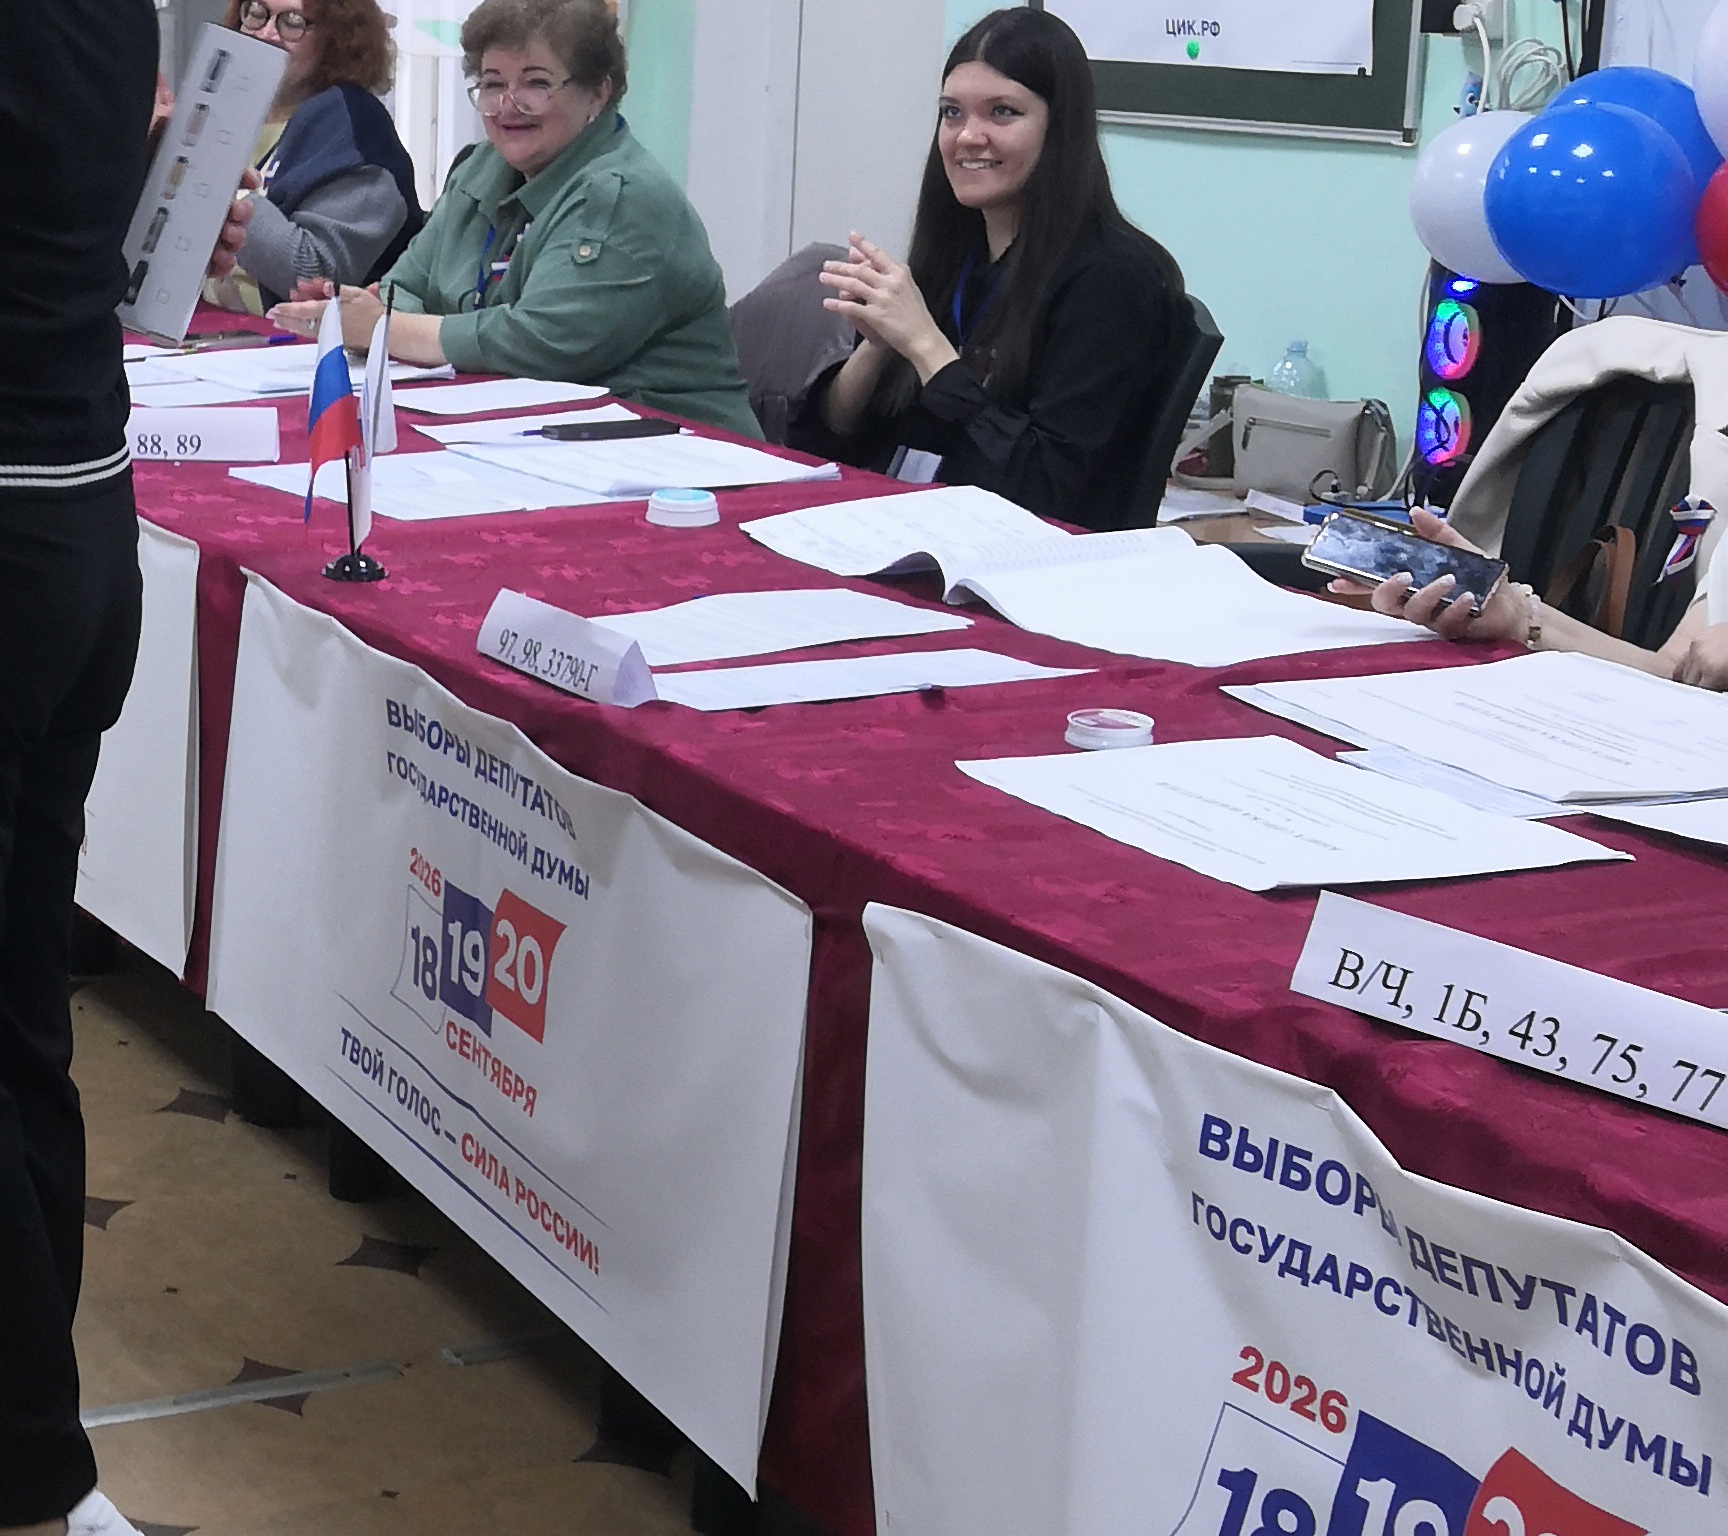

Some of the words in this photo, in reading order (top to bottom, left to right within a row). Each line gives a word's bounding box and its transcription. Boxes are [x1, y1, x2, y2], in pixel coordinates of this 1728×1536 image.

[1165, 19, 1221, 38] ЦИК.РФ
[136, 433, 168, 458] 88,
[176, 433, 202, 455] 89
[497, 628, 518, 664] 97,
[386, 698, 471, 768] ВЫБОРЫ
[531, 846, 590, 900] ДУМЫ
[411, 926, 438, 1001] 18
[447, 919, 486, 997] 19
[493, 918, 544, 1006] 20
[445, 1019, 537, 1118] СЕНТЯБРЯ
[1328, 947, 1414, 1019] В/Ч,
[1433, 983, 1490, 1045] 1Б,
[1508, 1009, 1568, 1072] 43,
[1590, 1033, 1648, 1099] 75,
[1671, 1060, 1728, 1112] 77
[341, 1027, 384, 1086] ТВОЙ
[387, 1066, 441, 1136] ГОЛОС
[461, 1132, 510, 1199] СИЛА
[514, 1175, 600, 1276] РОССИИ!
[1191, 1191, 1567, 1420] ГОСУДАРСТВЕННОЙ
[1567, 1391, 1712, 1496] ДУМЫ
[1406, 1225, 1702, 1397] ДЕПУТАТОВ
[1231, 1344, 1350, 1435] 2026
